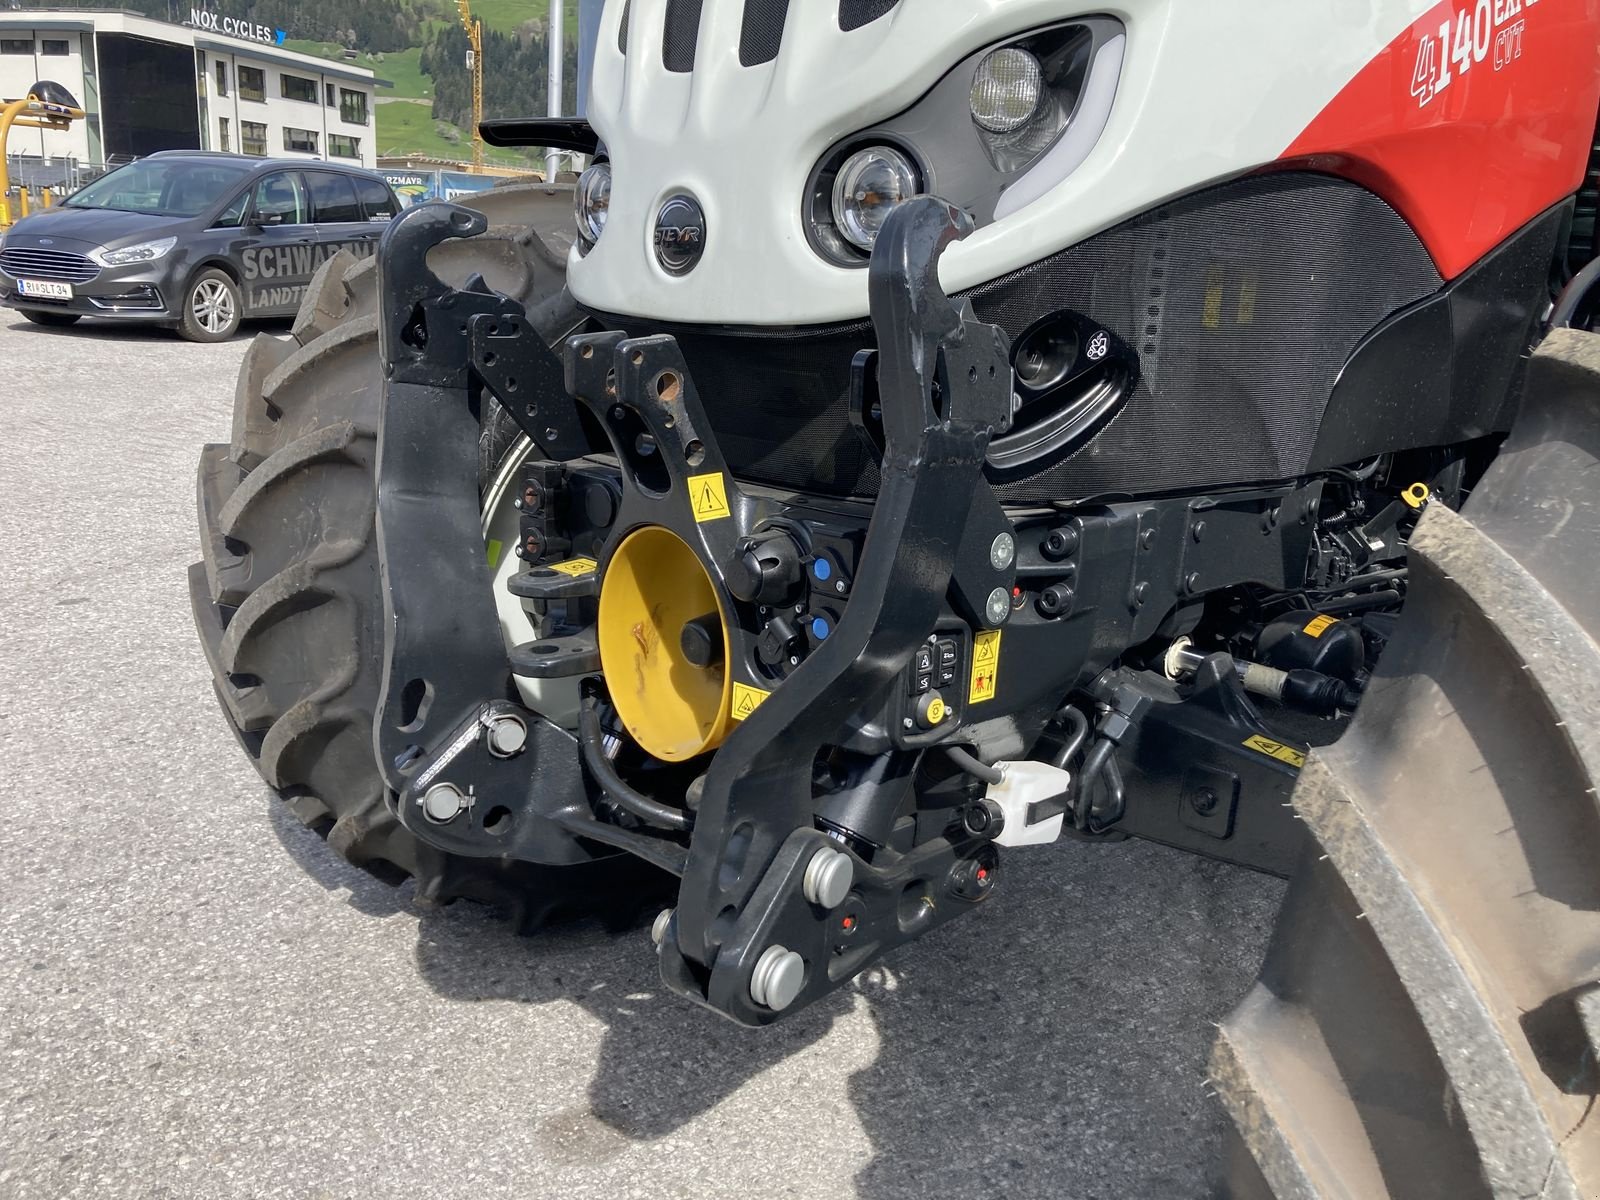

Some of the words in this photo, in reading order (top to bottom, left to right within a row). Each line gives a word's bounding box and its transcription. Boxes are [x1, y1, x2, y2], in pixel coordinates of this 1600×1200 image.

[191, 8, 218, 30] NOX
[223, 17, 271, 42] CYCLES
[1494, 19, 1525, 71] CVT
[1410, 0, 1492, 108] 4140
